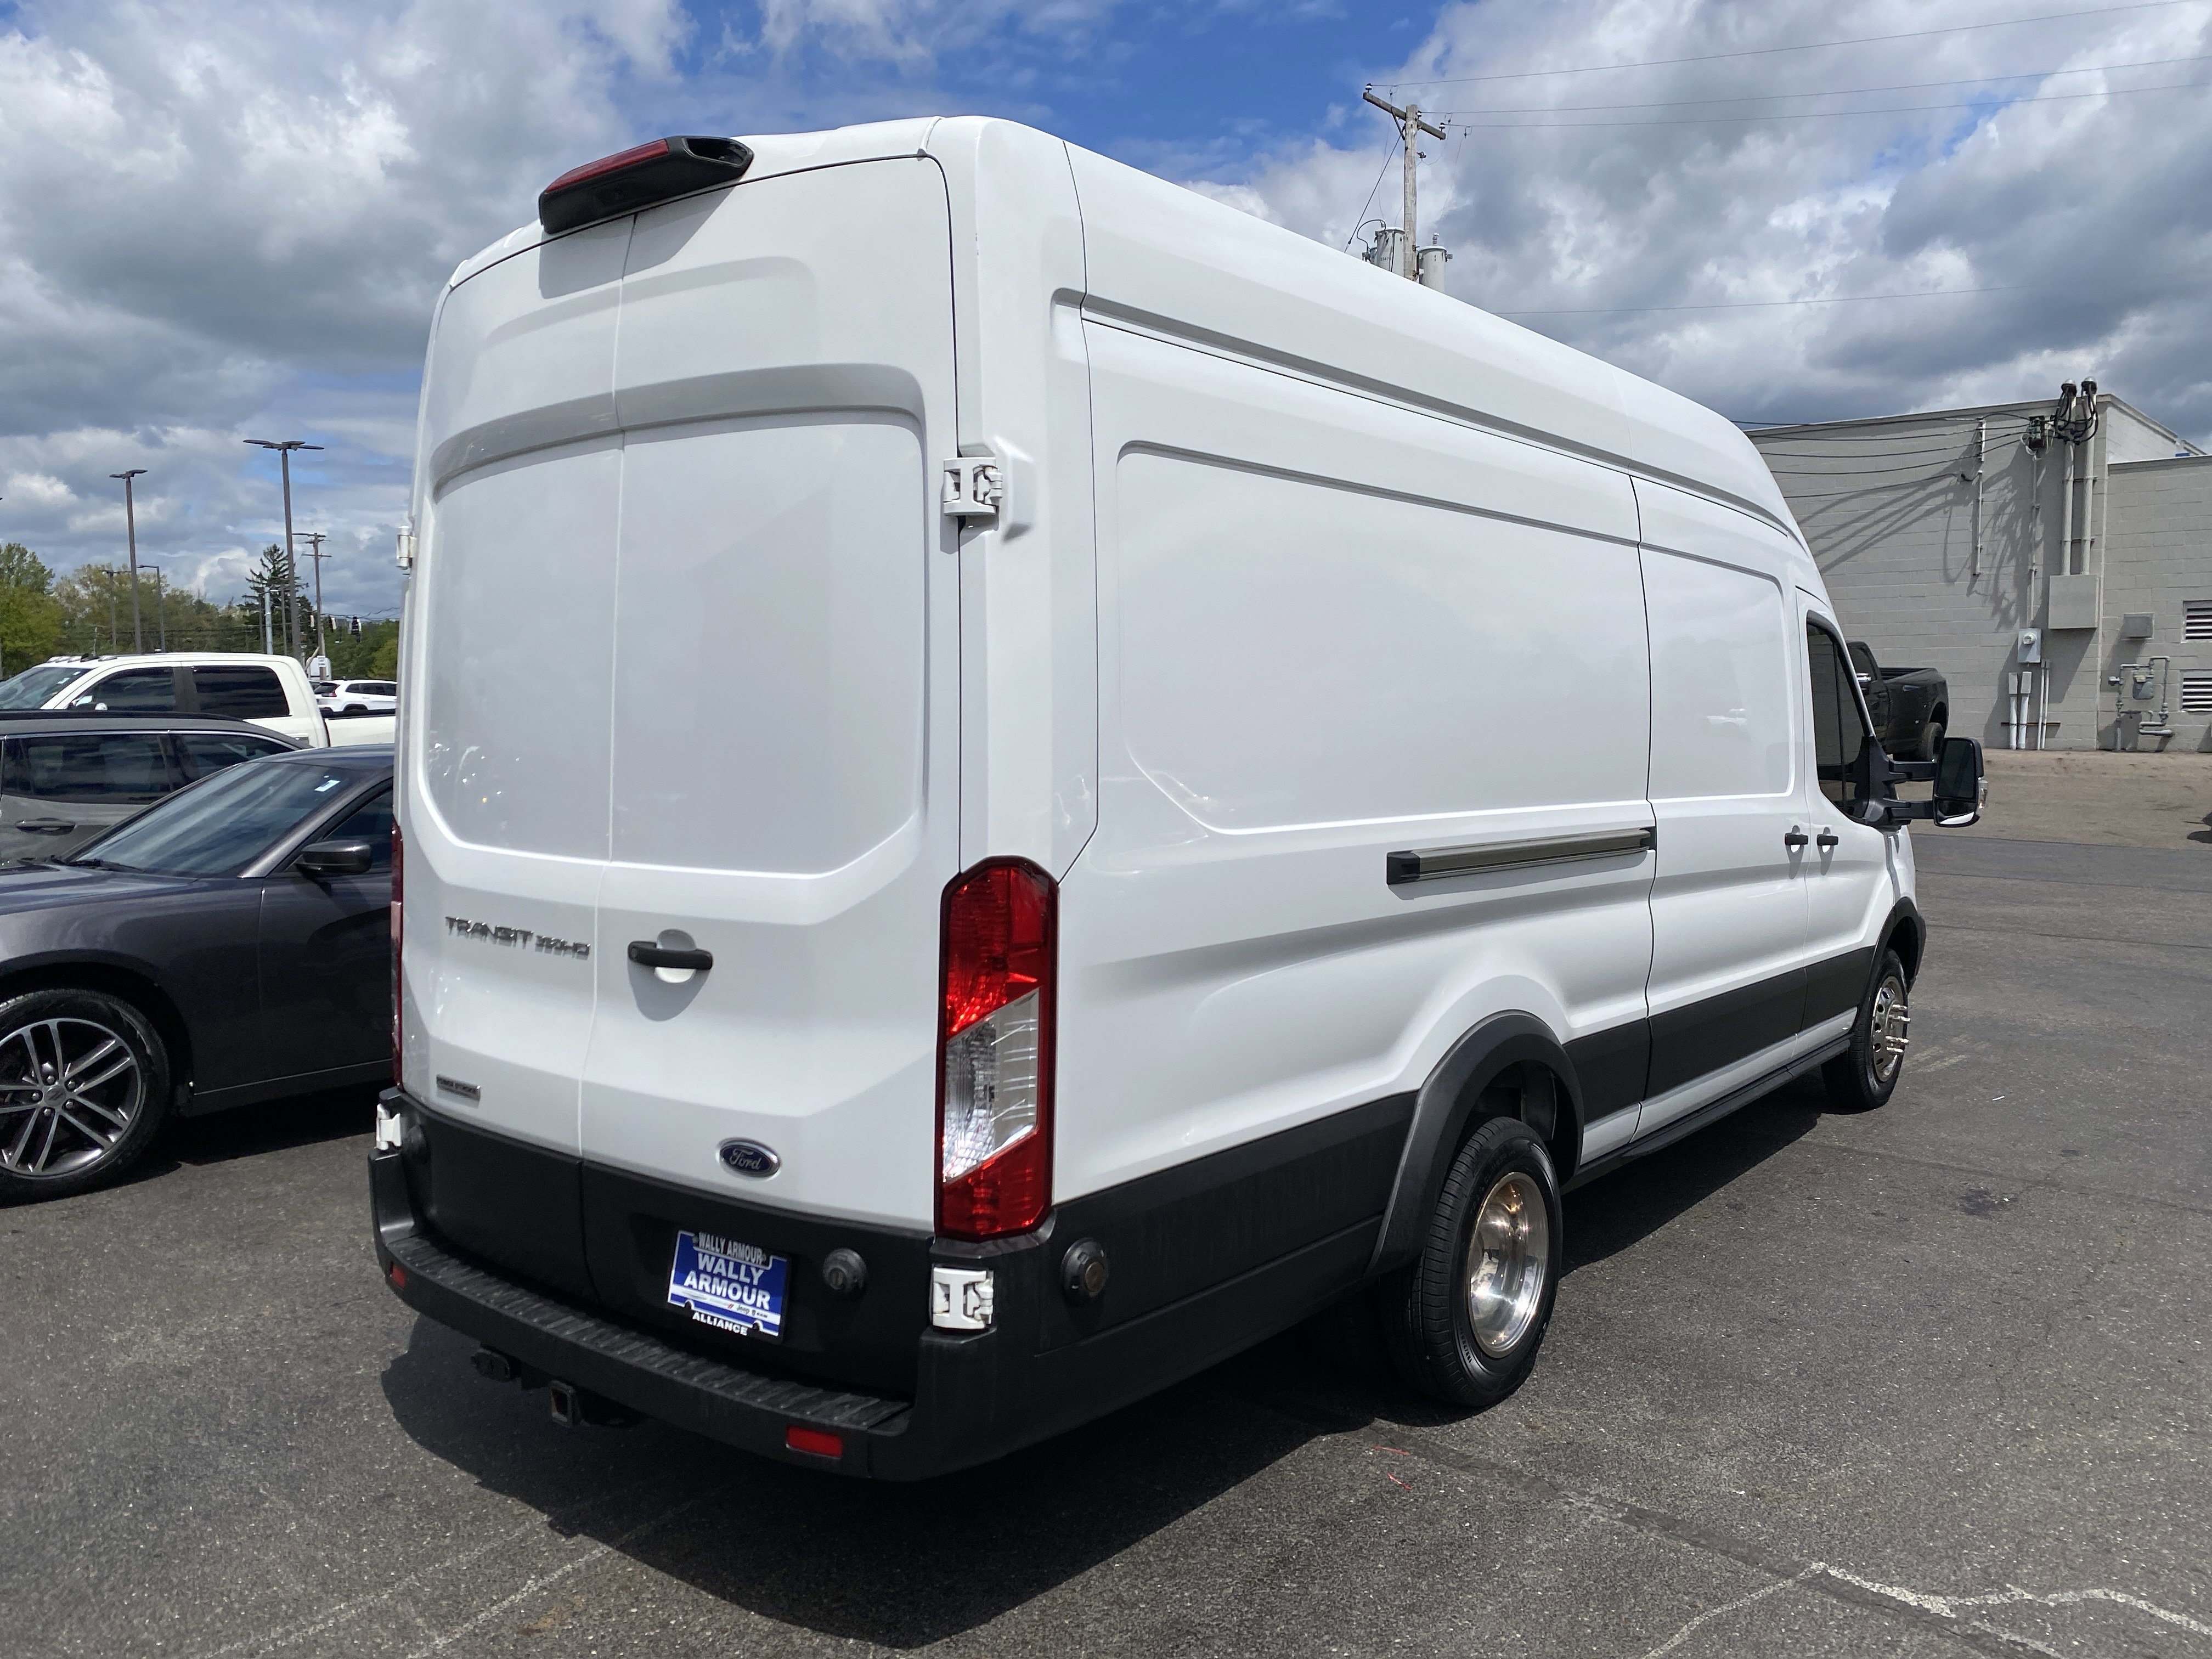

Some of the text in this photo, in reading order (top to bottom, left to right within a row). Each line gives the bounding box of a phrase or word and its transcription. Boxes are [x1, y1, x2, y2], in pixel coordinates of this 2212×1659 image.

[445, 916, 534, 945] TRANSIT
[729, 1148, 763, 1170] Ford
[698, 1232, 764, 1265] WALLY ARMOUR
[697, 1253, 765, 1286] WALLY
[684, 1270, 771, 1310] ARMOUR
[692, 1311, 748, 1336] ALLIANCE
